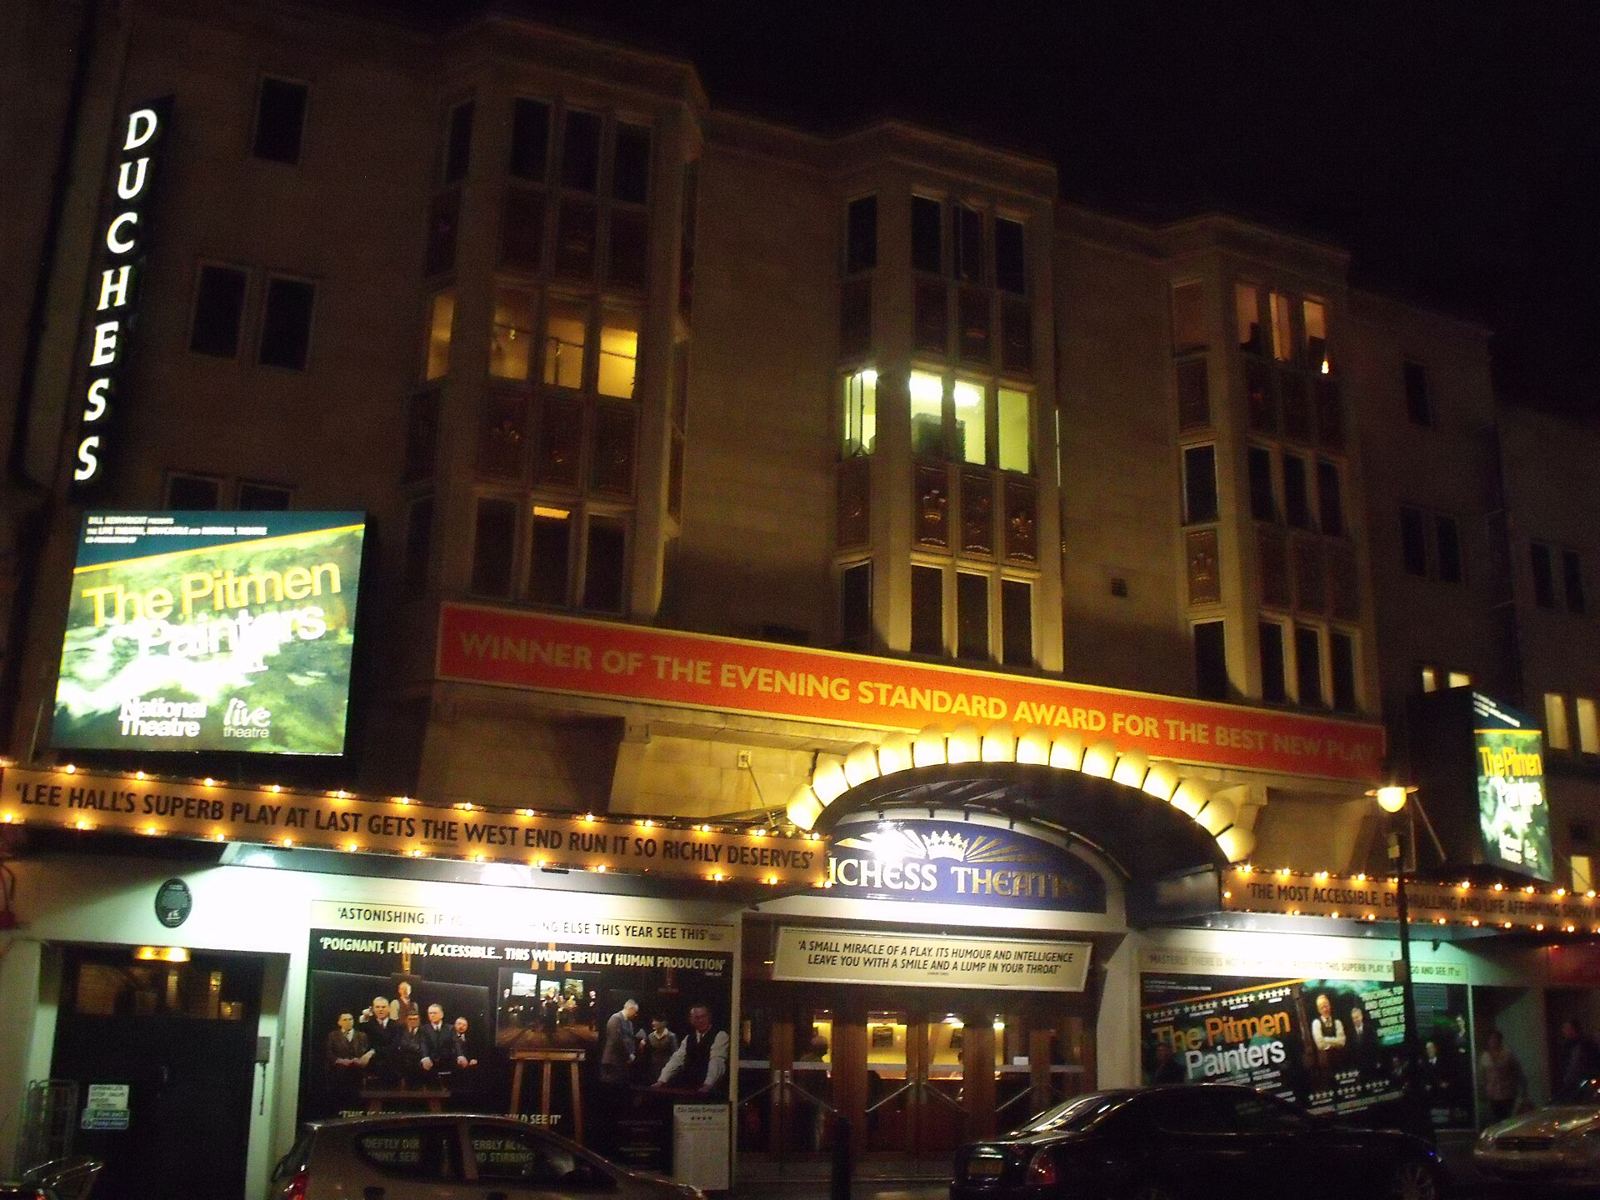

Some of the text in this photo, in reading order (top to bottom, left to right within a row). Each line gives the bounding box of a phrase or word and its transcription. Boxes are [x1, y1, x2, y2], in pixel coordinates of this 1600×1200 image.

[74, 109, 157, 481] DUCHESS
[82, 561, 341, 627] The Pitmen
[138, 605, 326, 658] Painters
[119, 697, 208, 721] National
[460, 631, 1374, 762] WINNER OF THE EVENING STANDARD AWARD FOR THE BEST NEW PLAY
[120, 716, 200, 737] Theatre
[224, 725, 270, 738] theatre
[68, 786, 136, 813] HALL'S
[143, 794, 224, 821] SUPERB
[230, 802, 282, 826] PLAY
[285, 808, 310, 828] AT
[315, 810, 361, 833] LAST
[367, 814, 416, 838] GETS
[422, 819, 458, 841] THE
[464, 822, 519, 846] WEST
[524, 828, 562, 849] END
[569, 831, 605, 853] RUN
[611, 836, 630, 856] IT
[634, 838, 657, 858] SO
[662, 840, 722, 864] RICHLY
[727, 846, 814, 870] DESERVES'
[1278, 885, 1310, 902] MOST
[564, 922, 590, 935] ELSE
[595, 924, 620, 936] THIS
[624, 925, 653, 938] YEAR
[657, 927, 676, 939] SEE
[387, 941, 428, 957] FUNNY,
[505, 948, 530, 961] THIS
[532, 949, 614, 965] WONDERFULLY
[615, 954, 653, 968] HUMAN
[808, 954, 837, 966] LEAVE
[840, 956, 860, 967] YOU
[863, 957, 888, 969] WITH
[891, 959, 898, 968] A
[900, 959, 928, 970] SMILE
[930, 960, 949, 970] AND
[952, 961, 958, 971] A
[960, 961, 986, 972] LUMP
[988, 962, 997, 972] IN
[1000, 963, 1024, 973] YOUR
[809, 941, 840, 952] SMALL
[843, 943, 884, 955] MIRACLE
[887, 945, 899, 955] OF
[901, 946, 907, 956] A
[936, 948, 949, 958] ITS
[951, 949, 991, 960] HUMOUR
[994, 950, 1011, 961] AND
[1014, 951, 1074, 963] INTELLIGENCE
[1152, 1011, 1291, 1054] The Pitmen
[1185, 1040, 1286, 1080] Painters
[530, 1114, 548, 1125] SEE
